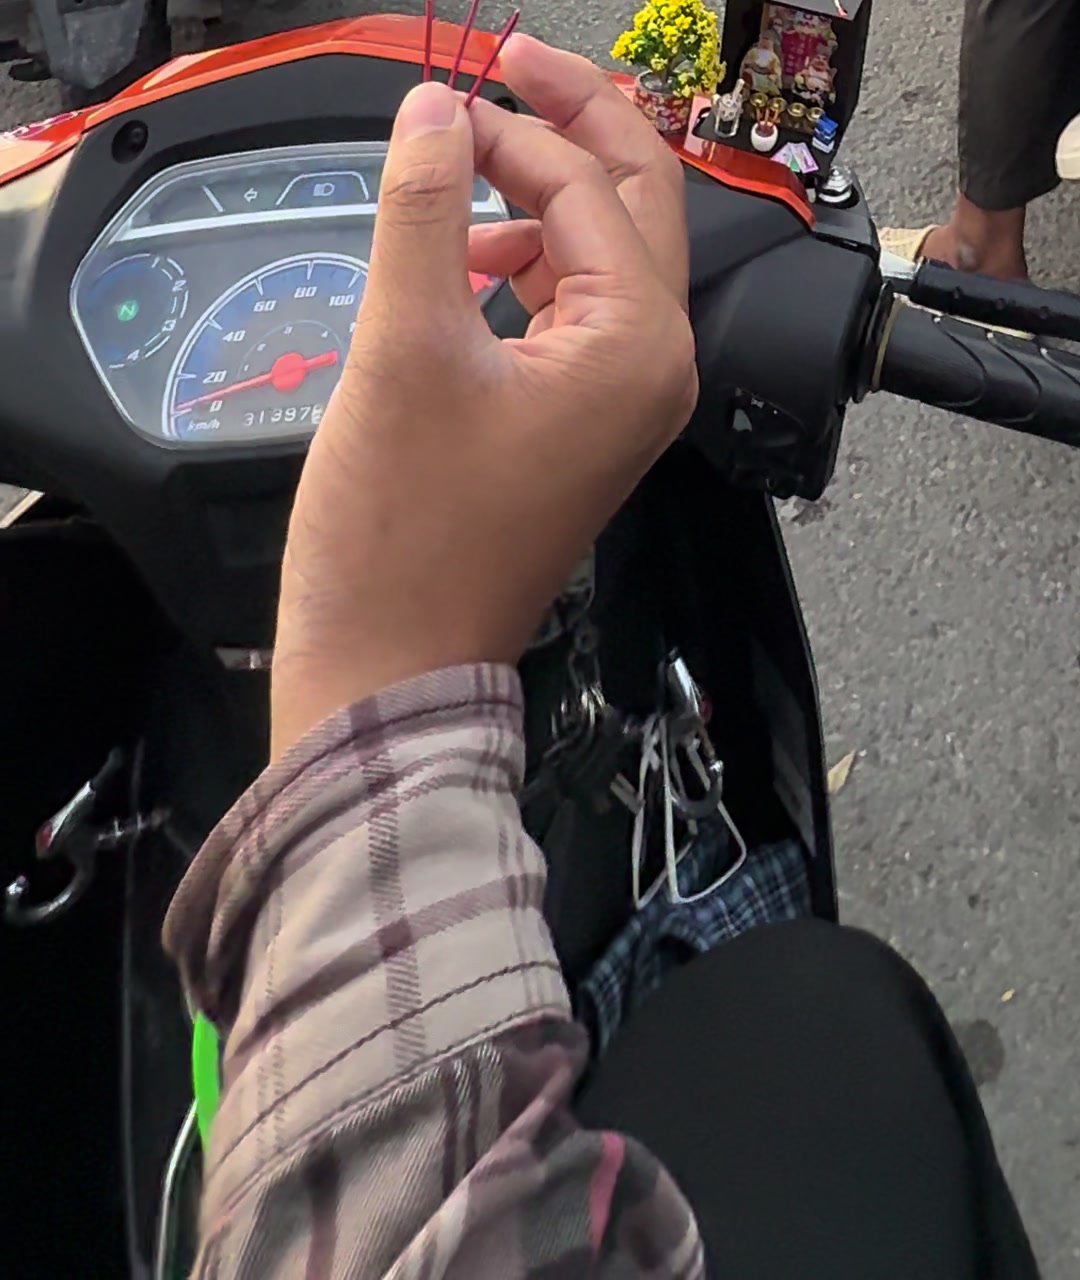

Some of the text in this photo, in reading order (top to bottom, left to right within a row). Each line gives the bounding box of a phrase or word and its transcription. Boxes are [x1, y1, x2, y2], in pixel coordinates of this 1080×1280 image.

[293, 286, 318, 299] 80
[253, 300, 277, 312] 60
[328, 294, 355, 307] 100
[119, 303, 137, 318] N
[222, 329, 246, 342] 40
[202, 370, 228, 384] 20
[209, 399, 223, 413] 0
[186, 417, 221, 432] km/h
